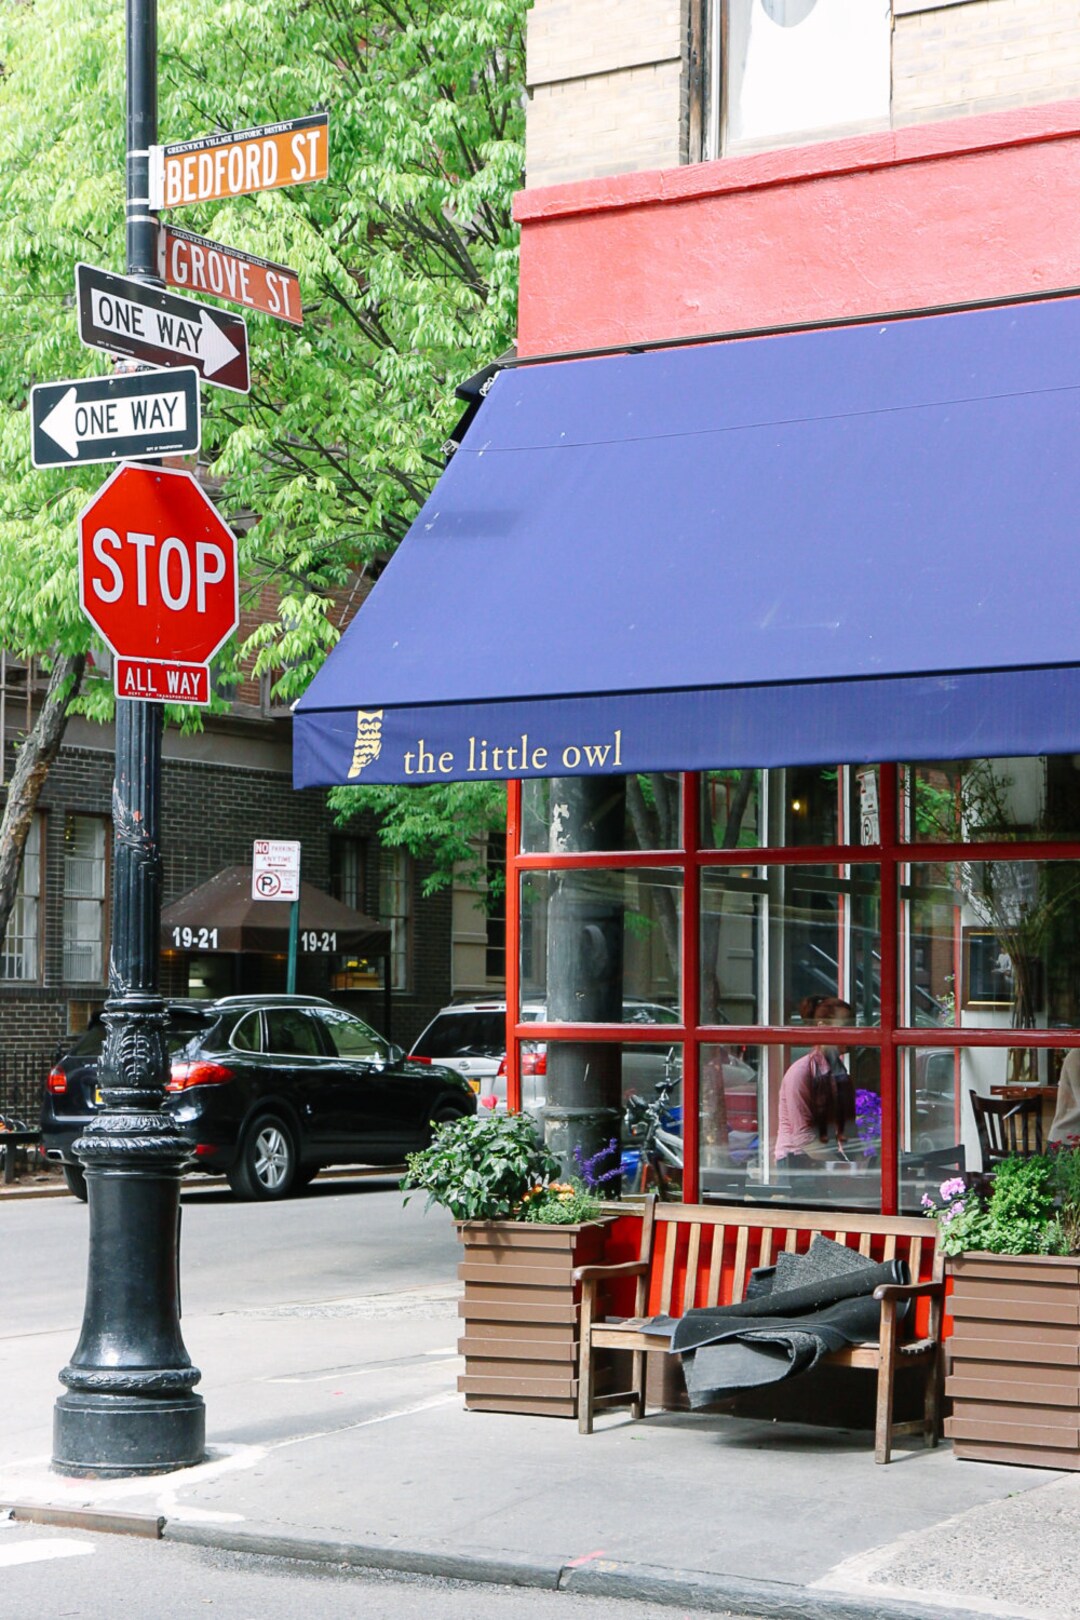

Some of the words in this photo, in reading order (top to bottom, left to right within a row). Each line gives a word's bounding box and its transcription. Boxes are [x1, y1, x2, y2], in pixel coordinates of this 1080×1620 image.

[206, 135, 233, 148] VILLAGE
[167, 140, 278, 205] BEDFORD
[291, 131, 320, 182] ST
[171, 239, 254, 304] GROVE
[265, 271, 290, 316] ST
[99, 296, 145, 337] ONE
[156, 314, 203, 353] WAY
[75, 404, 118, 436] ONE
[131, 396, 178, 430] WAY
[92, 527, 226, 613] STOP
[124, 667, 157, 692] ALL
[166, 670, 201, 695] WAY
[403, 739, 453, 775] the
[467, 734, 548, 772] little
[562, 730, 623, 769] owl
[255, 842, 269, 854] NO
[172, 926, 218, 949] 19-21
[301, 931, 337, 951] 19-21
